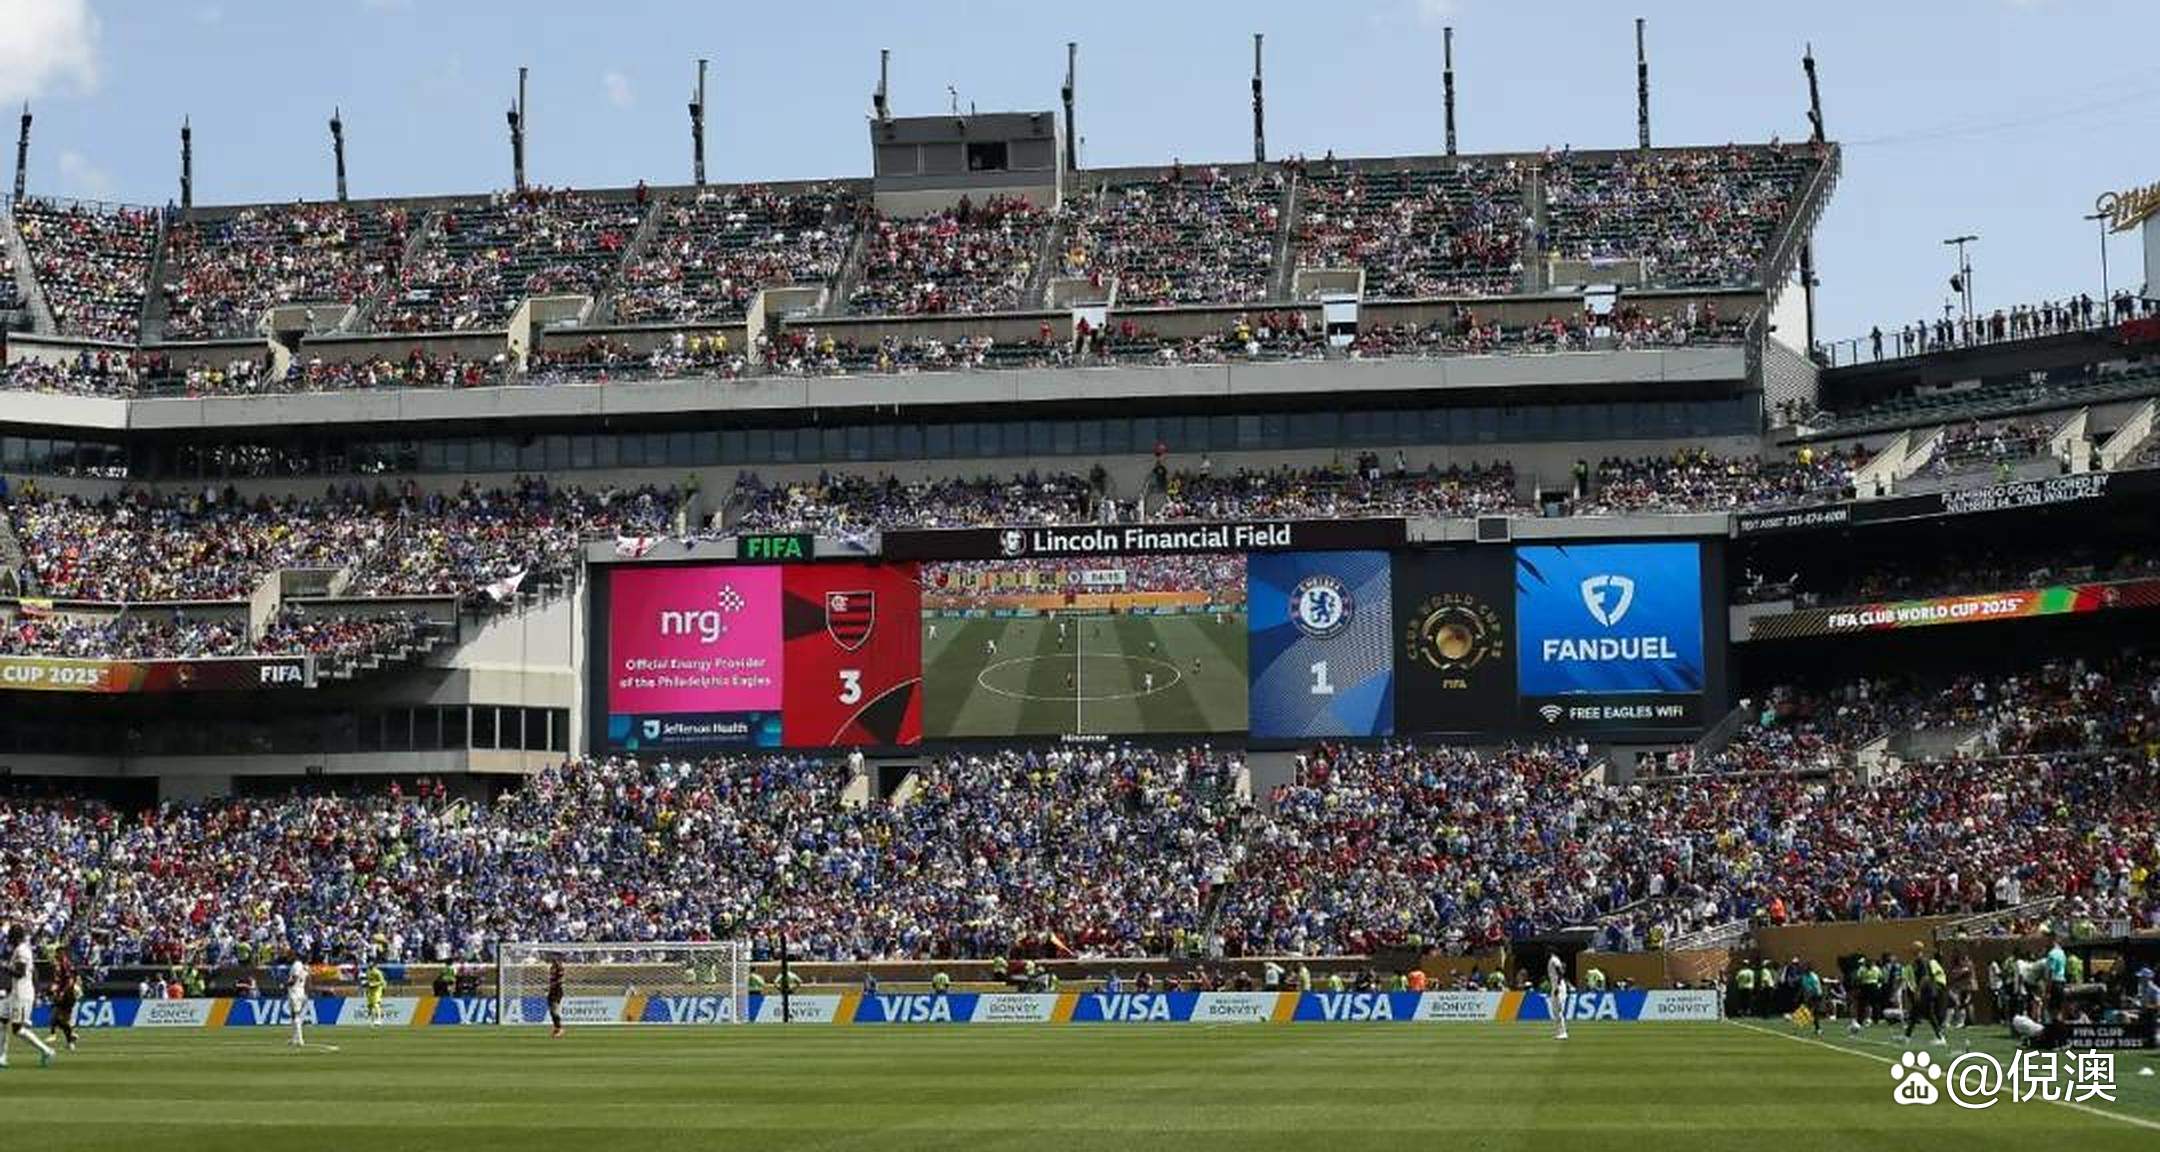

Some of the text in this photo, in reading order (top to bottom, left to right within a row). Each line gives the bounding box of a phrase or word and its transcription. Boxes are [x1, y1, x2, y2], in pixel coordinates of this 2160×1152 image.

[2007, 481, 2040, 497] GOAL
[748, 537, 803, 557] FIFA
[1033, 525, 1291, 551] Lincoln Financial Field
[661, 610, 721, 643] nrg
[1828, 614, 1858, 628] FIFA
[1860, 610, 1895, 625] CLUB
[1898, 605, 1948, 622] WORLD
[1950, 601, 1979, 617] CUP
[1543, 637, 1677, 661] FANDUEL
[3, 666, 43, 683] CUP
[261, 666, 302, 681] FIFA
[1311, 661, 1334, 694] 1
[839, 670, 862, 704] 3
[1569, 706, 1600, 719] FREE
[1603, 705, 1653, 718] EAGLES
[877, 995, 951, 1021] VISA
[1093, 994, 1171, 1020] VISA
[1313, 993, 1393, 1020] VISA
